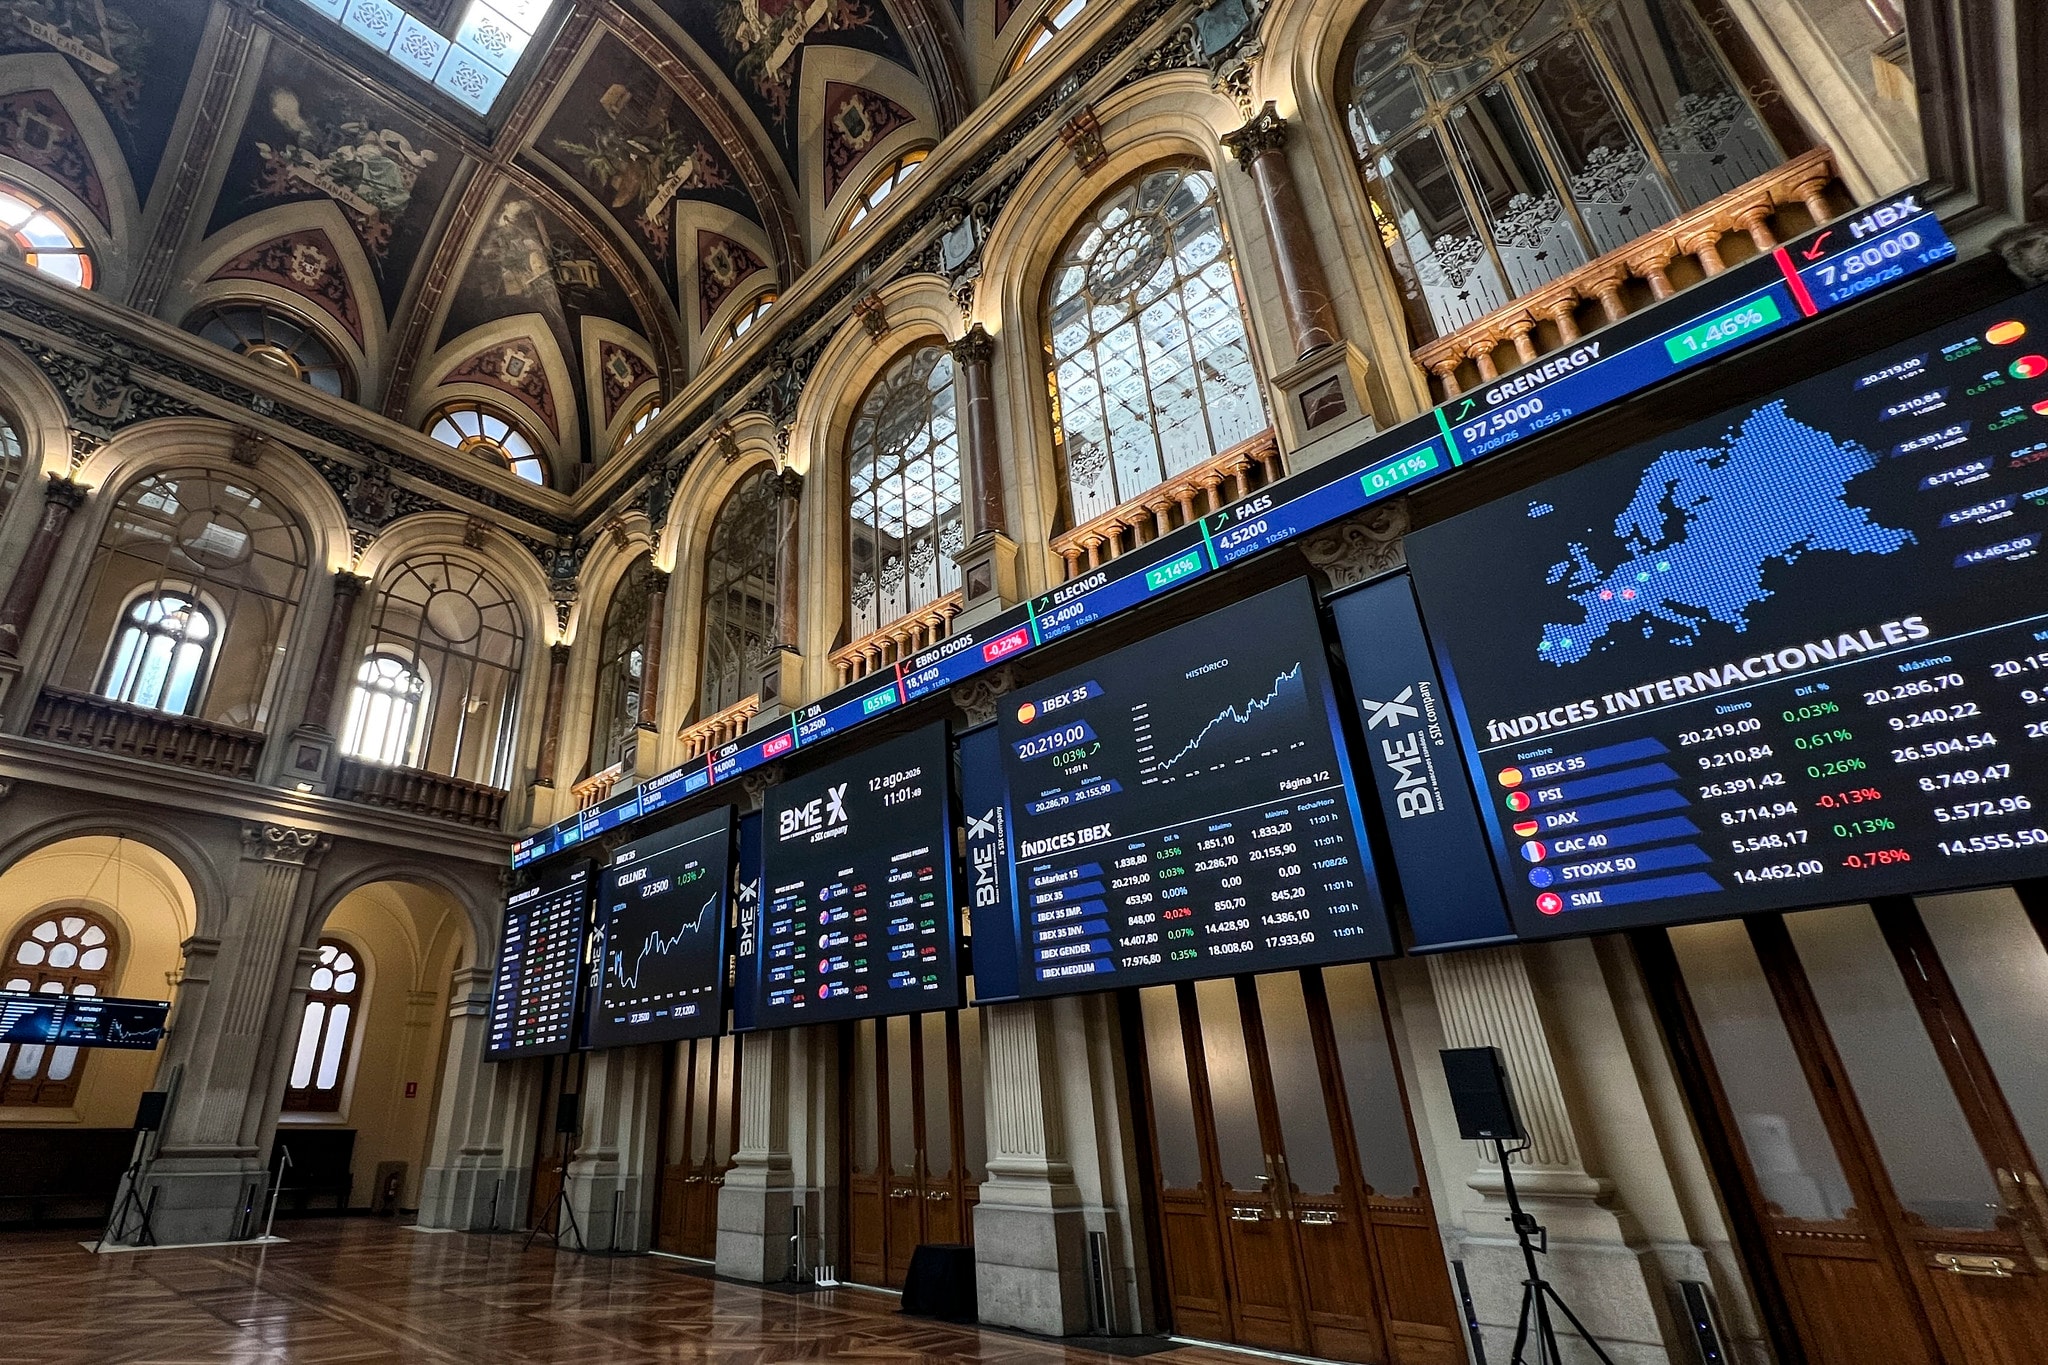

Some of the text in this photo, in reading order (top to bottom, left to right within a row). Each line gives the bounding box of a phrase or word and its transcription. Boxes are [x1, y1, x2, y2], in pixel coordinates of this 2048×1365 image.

[1849, 195, 1923, 239] HBX
[1816, 230, 1922, 286] 7,8000
[1829, 264, 1904, 302] 12/08/26
[1463, 308, 1763, 443] 97,5000 1,46%
[1485, 341, 1602, 406] GRENERGY
[1861, 358, 1921, 386] 20.219,00
[1887, 392, 1942, 416] 9.210,84
[1470, 410, 1561, 456] 12/08/26 10:55
[1900, 426, 1964, 452] 26.391,42
[1927, 461, 1985, 486] 8.714,94
[1219, 455, 1427, 549] 4,5200 0,11%
[1235, 494, 1273, 520] FAES
[1949, 499, 2007, 523] 5.548,17
[1223, 528, 1289, 562] 12/08/26 10:55
[1963, 538, 2033, 562] 14.462,00
[1040, 559, 1194, 630] 33,4000 2,14%
[1053, 571, 1108, 605] ELECNOR
[906, 635, 1022, 689] 18,1400 -0,22%
[915, 634, 974, 668] EBRO FOODS
[1185, 658, 1229, 680] HISTÓRICO
[1486, 616, 1930, 743] ÍNDICES INTERNACIONALES
[807, 704, 822, 718] DIA
[867, 693, 891, 710] 0,51%
[1042, 687, 1088, 713] IBEX 35
[1417, 681, 1438, 722] company
[1517, 746, 1554, 761] Nombre
[1898, 654, 1953, 673] Máximo
[799, 718, 827, 737] 39,2500
[1018, 725, 1084, 759] 20.219,00
[1427, 723, 1442, 740] SIX
[1529, 759, 1564, 779] IBEX
[1566, 756, 1586, 771] 35
[1678, 717, 1762, 746] 20.219,00
[1782, 700, 1840, 723] 0,03%
[1862, 673, 1965, 706] 20.286,70
[1052, 748, 1086, 767] 0,03%
[1064, 765, 1082, 776] 11:01
[1537, 702, 1982, 803] PSI 9.210,84 0,61% 9.240,22
[868, 777, 882, 792] 12
[1280, 770, 1330, 791] Página 1/2
[1381, 732, 1436, 819] BME
[1545, 731, 1998, 828] DAX 26.391,42 0,26% 26.504,54
[780, 797, 823, 836] BME
[1035, 784, 1111, 813] 20.286,70 20.155,90
[1554, 763, 2011, 854] CAC 40 8.714,94 -0,13% 8.749,47
[1021, 823, 1112, 858] ÍNDICES IBEX
[1034, 814, 1330, 886] G.Market 15 1.838,80 0,35% 1.851,10 1.833,20 11:01
[1561, 795, 2032, 880] STOXX 50 5.548,17 0,13% 5.572,96
[617, 867, 648, 887] CELLNEX
[642, 870, 697, 898] 27,3500 1,03%
[973, 843, 996, 907] BME
[1036, 836, 1335, 904] IBEX 35 20.219,00 0,03% 20.286,70 20.155,90 11:01
[1570, 828, 2048, 906] SMI 14.462,00 -0,78% 14.555,50
[1037, 856, 1348, 922] IBEX 35 IMP. 453,90 0,00% 0,00 0,00 11/08/26
[1039, 881, 1345, 941] IBEX 35 INV. 848,00 -0,02% 850,70 845,20 11:01
[739, 906, 754, 957] BME
[1040, 904, 1350, 959] IBEX GENDER 14.407,80 0,07% 14.428,90 14.386,10 11:01
[1042, 926, 1355, 979] IBEX MEDIUM 17.976,80 0,35% 18.008,60 17.933,60 11:01
